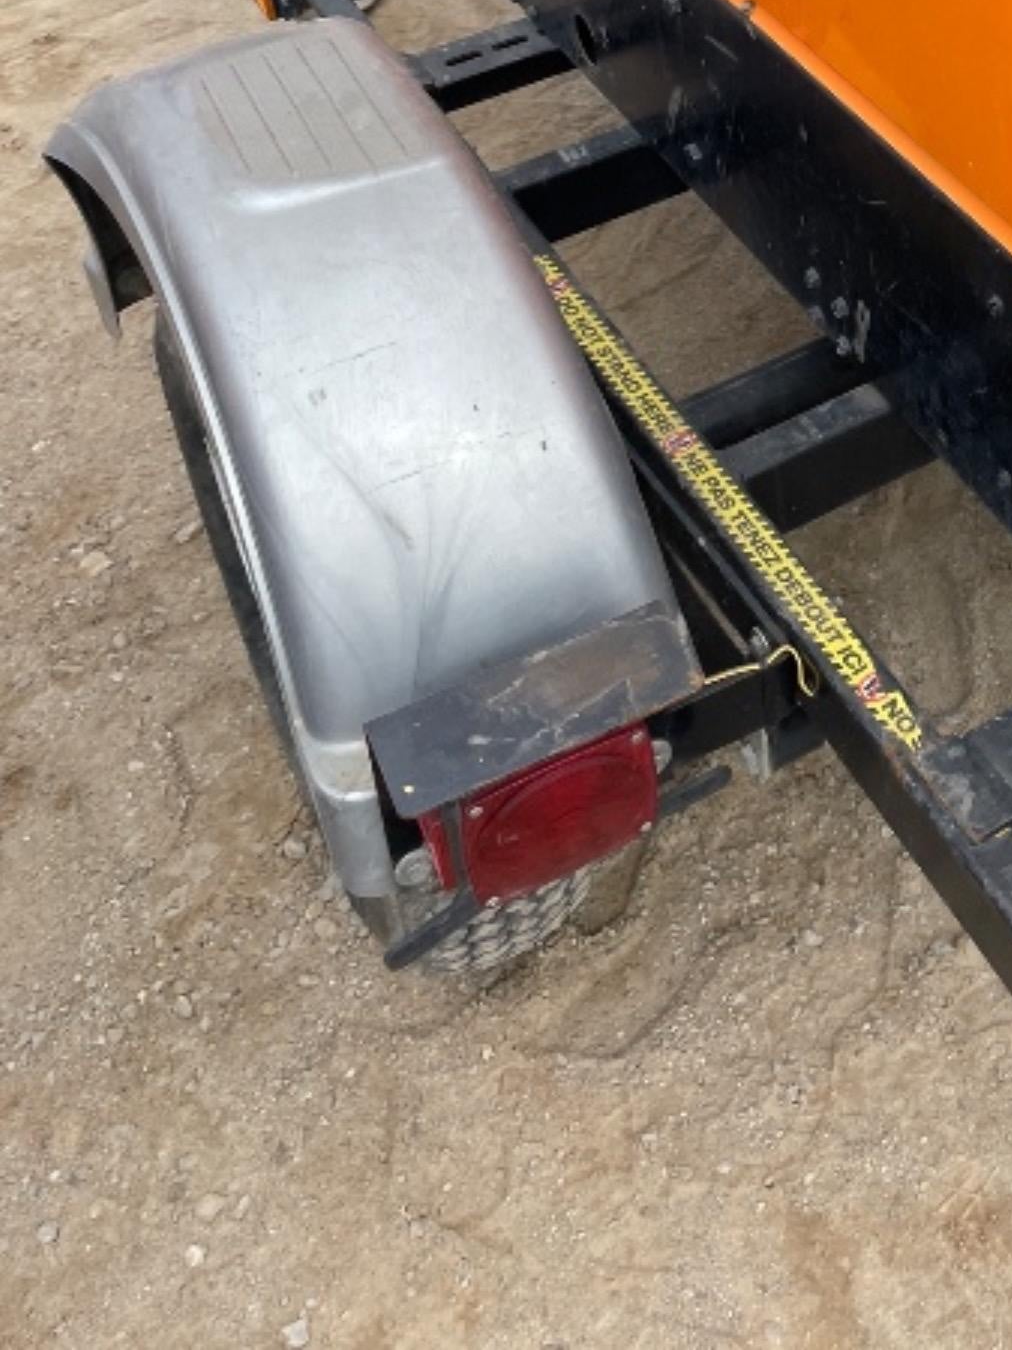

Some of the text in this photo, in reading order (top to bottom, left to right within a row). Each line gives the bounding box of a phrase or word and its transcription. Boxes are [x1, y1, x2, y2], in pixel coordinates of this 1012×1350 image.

[704, 474, 737, 511] PAS
[731, 508, 782, 569] TENEZ
[775, 566, 845, 643] DEBOUT
[836, 640, 870, 674] ICI
[881, 696, 916, 734] NO
